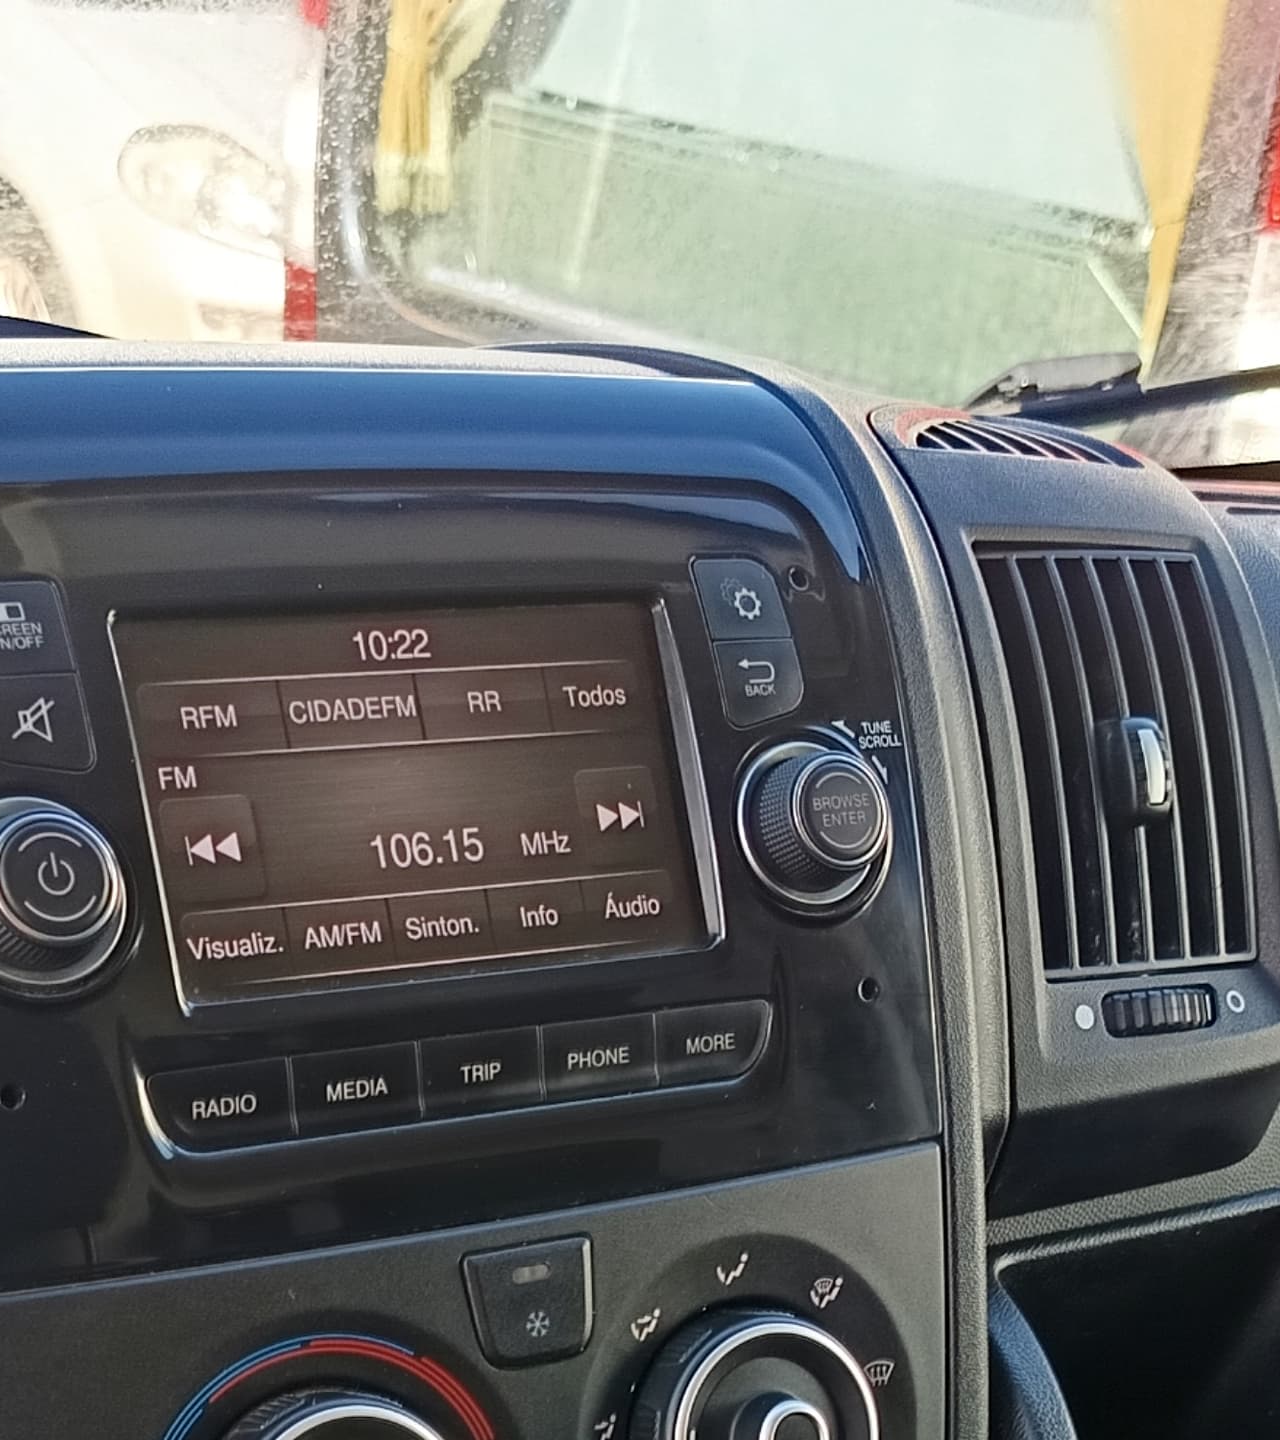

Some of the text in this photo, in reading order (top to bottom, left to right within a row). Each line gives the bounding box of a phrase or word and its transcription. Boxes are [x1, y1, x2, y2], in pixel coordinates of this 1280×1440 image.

[353, 629, 431, 660] 10:22
[468, 691, 501, 712] RR
[562, 684, 626, 707] Todos
[745, 684, 776, 696] BACK
[181, 704, 237, 729] RFM
[289, 695, 416, 723] CIDADEFM
[861, 720, 892, 734] TUNE
[859, 734, 902, 749] SCROLL
[158, 766, 196, 789] FM
[813, 793, 870, 810] BROWSE
[823, 811, 866, 827] ENTER
[371, 828, 571, 868] 106.15 MHz
[520, 905, 558, 927] Info
[606, 892, 659, 918] Áudio
[306, 921, 381, 949] AM/FM
[406, 916, 479, 939] Sinton.
[187, 932, 283, 959] Visualiz.
[687, 1033, 735, 1053] MORE
[568, 1047, 629, 1069] PHONE
[461, 1063, 500, 1083] TRIP
[327, 1078, 387, 1101] MEDIA
[193, 1095, 256, 1119] RADIO
